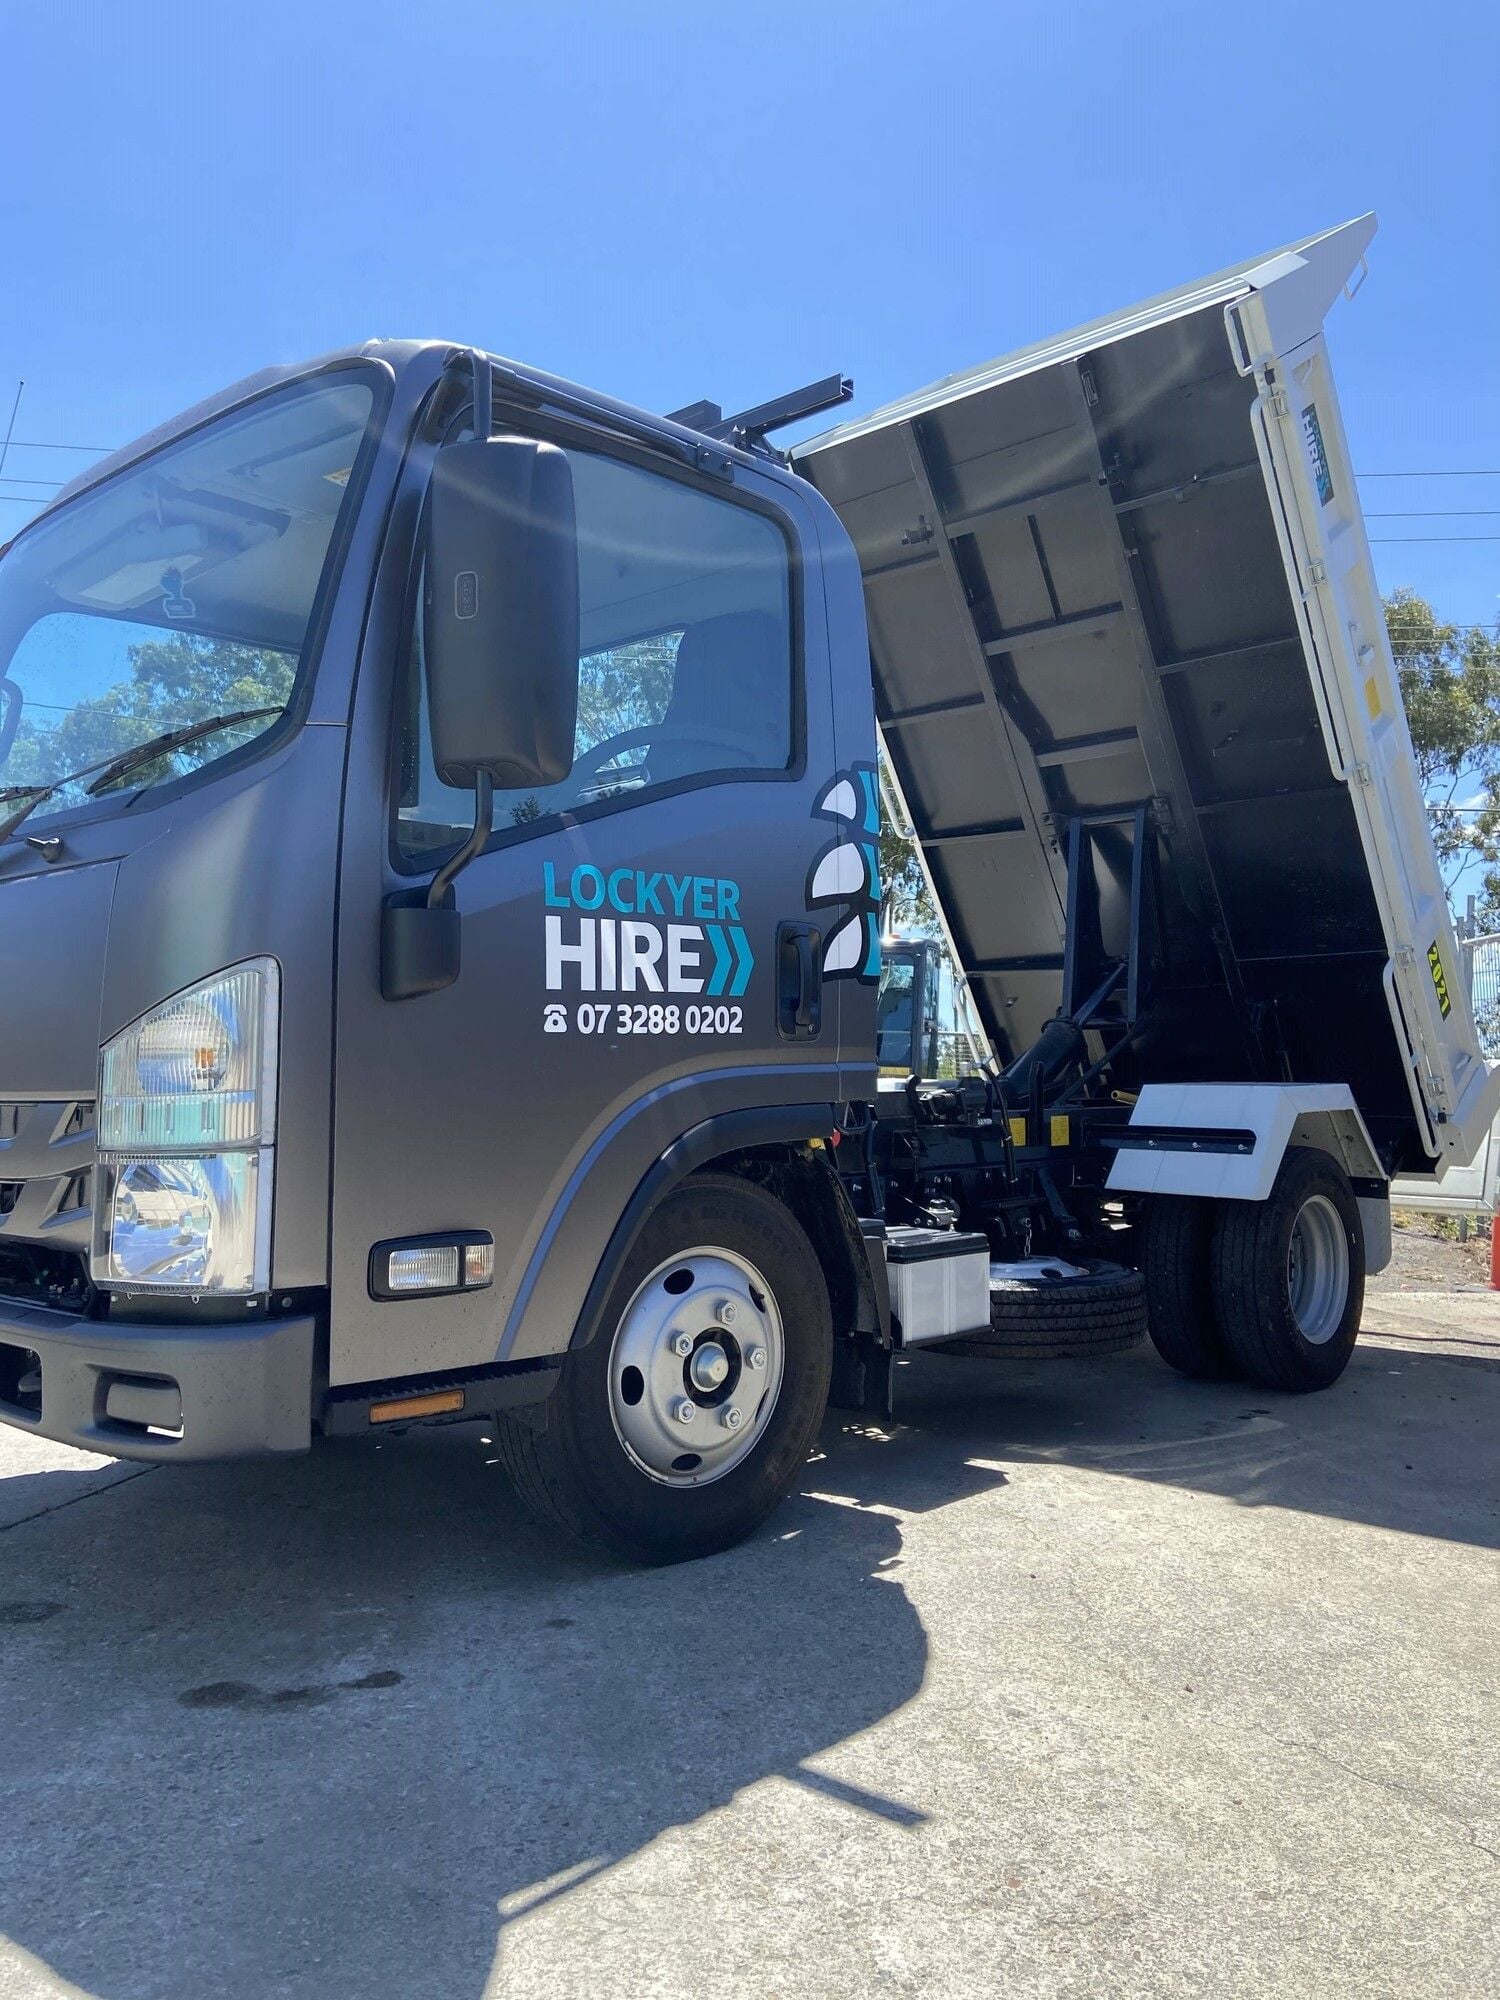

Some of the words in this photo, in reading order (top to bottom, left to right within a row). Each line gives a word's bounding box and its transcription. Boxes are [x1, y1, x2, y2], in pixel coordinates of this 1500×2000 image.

[1302, 413, 1323, 479] HIRE
[543, 861, 741, 921] LOCKYER
[545, 915, 705, 993] HIRE
[1428, 946, 1449, 1013] 2021
[577, 1003, 611, 1034] 07
[616, 1004, 680, 1034] 3288
[685, 1005, 743, 1034] 0202
